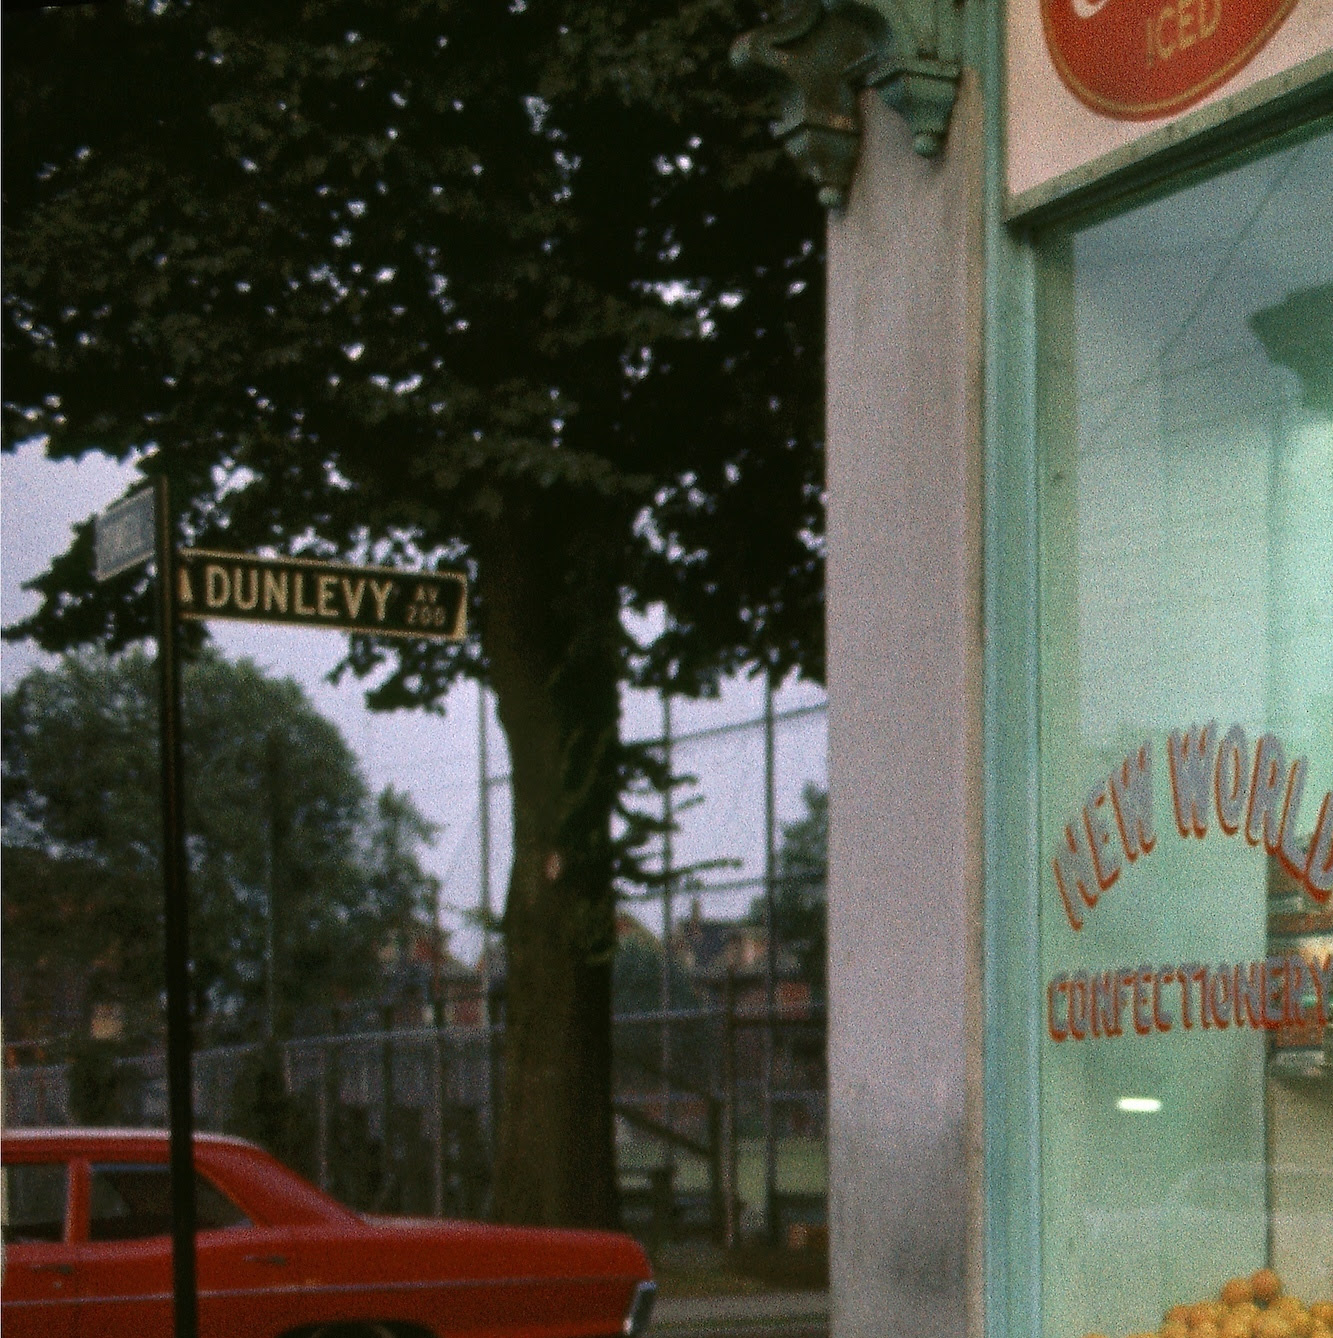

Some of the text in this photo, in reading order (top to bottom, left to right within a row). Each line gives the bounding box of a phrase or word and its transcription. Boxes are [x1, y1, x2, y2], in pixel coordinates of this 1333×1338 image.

[205, 564, 440, 621] DUNLEVY AV
[405, 605, 446, 627] 200
[1052, 743, 1157, 933] NEW
